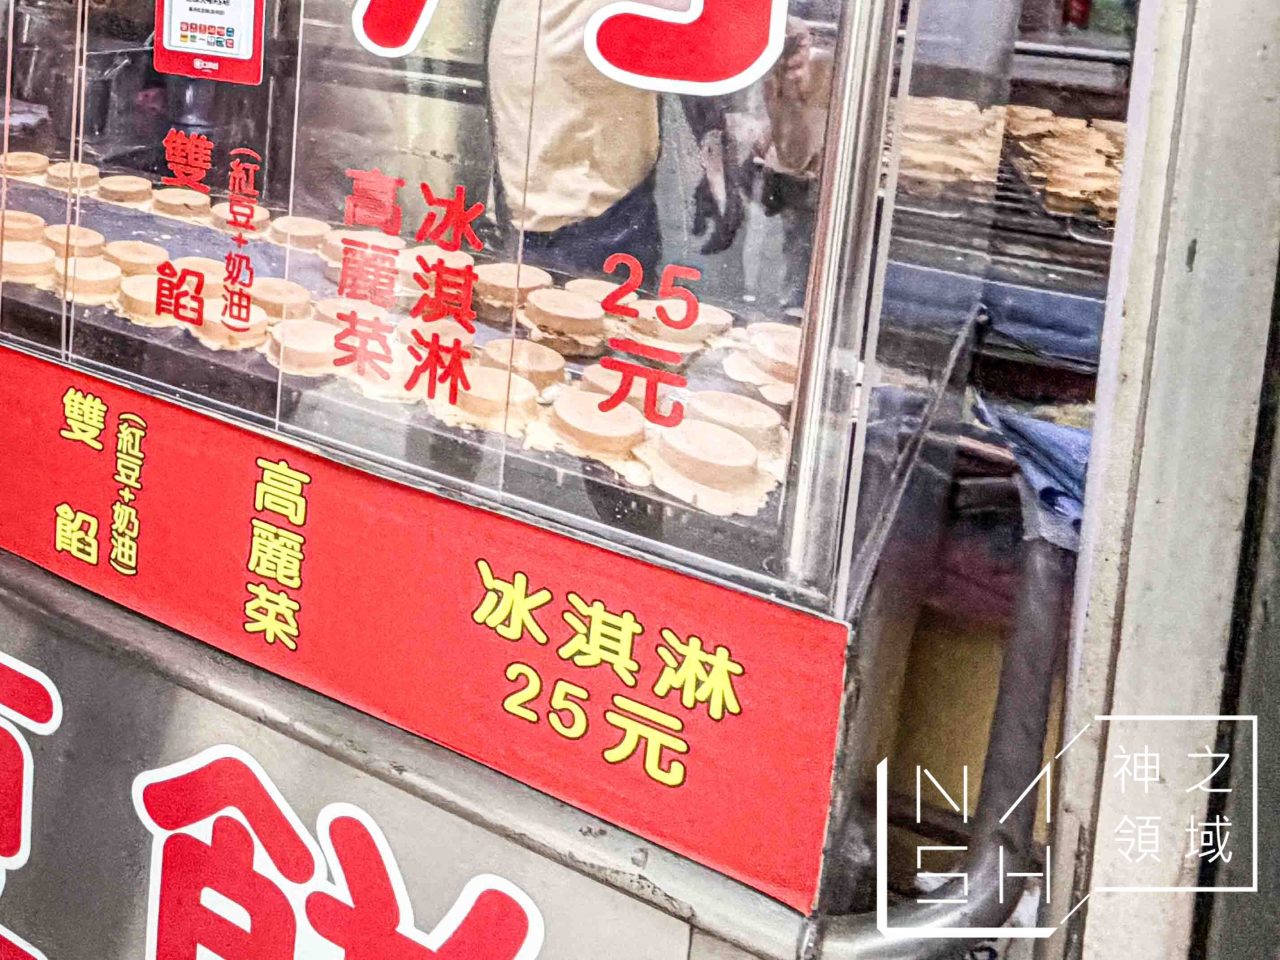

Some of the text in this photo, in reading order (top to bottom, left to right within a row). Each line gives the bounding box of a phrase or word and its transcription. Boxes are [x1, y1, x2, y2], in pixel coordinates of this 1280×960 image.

[155, 128, 214, 327] 雙餡
[404, 182, 485, 405] 冰淇淋
[54, 386, 108, 566] 雙餡
[243, 457, 311, 651] 高麗菜
[472, 559, 745, 720] 冰淇淋
[502, 662, 690, 787] 25元
